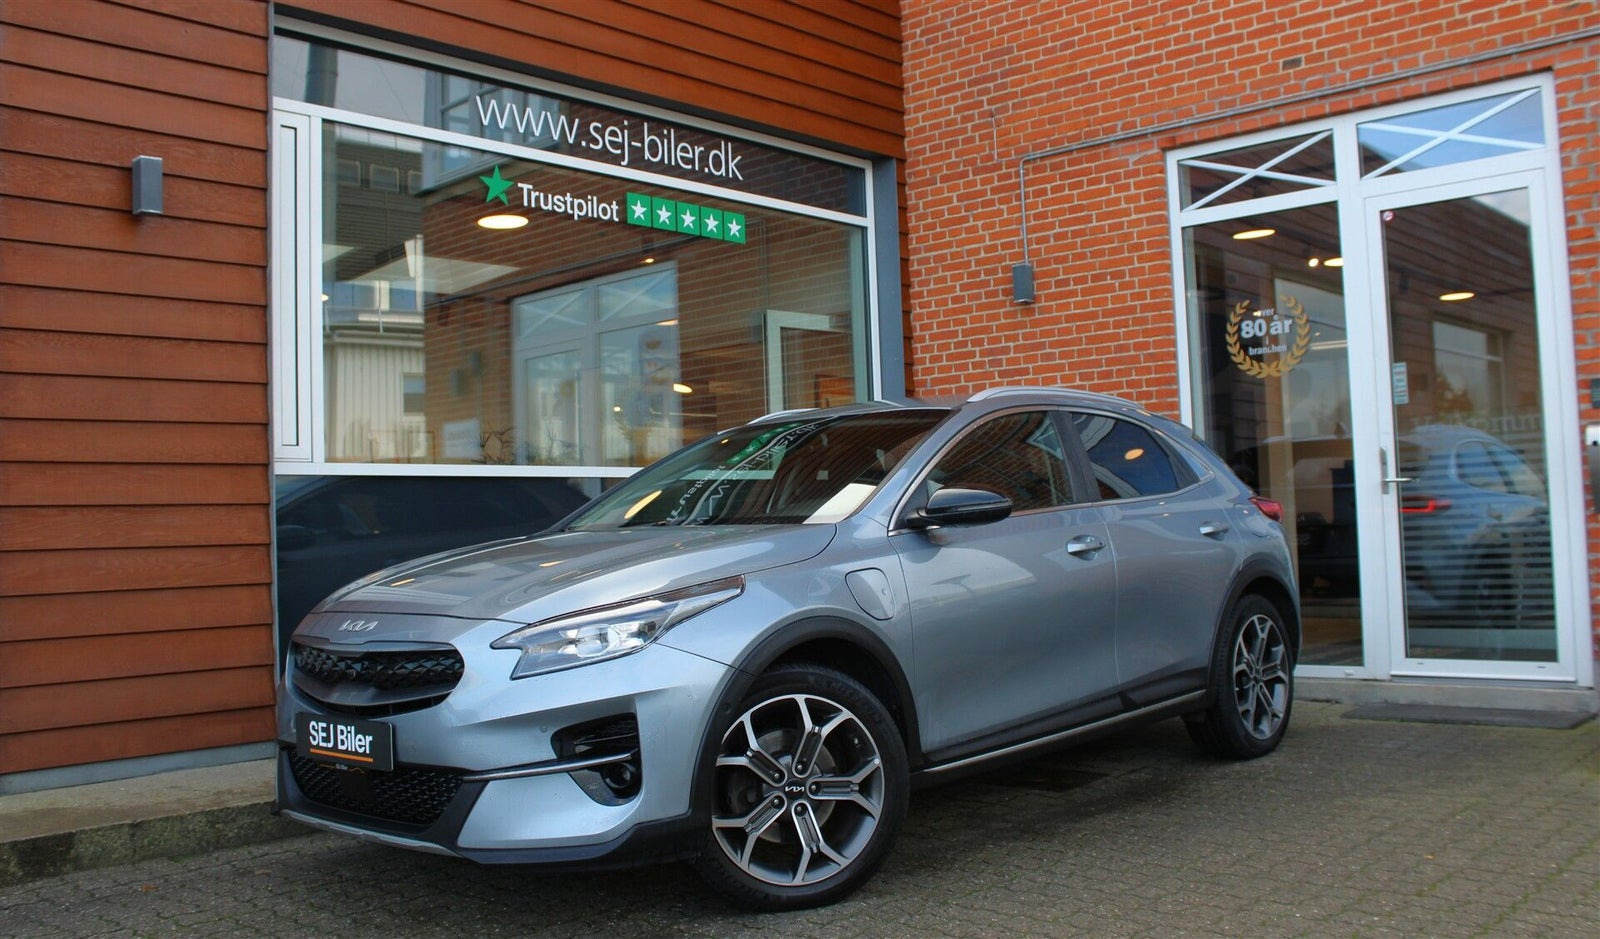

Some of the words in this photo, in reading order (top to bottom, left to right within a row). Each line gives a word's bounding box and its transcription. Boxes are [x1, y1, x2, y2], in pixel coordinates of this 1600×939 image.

[476, 95, 744, 181] www.sej-biler.dk
[517, 182, 619, 222] Trustpilot
[1241, 318, 1267, 338] 80
[1270, 315, 1292, 335] år
[1248, 344, 1287, 355] branchen
[338, 619, 379, 632] KIA
[309, 720, 334, 748] SEJ
[337, 724, 373, 754] Biler
